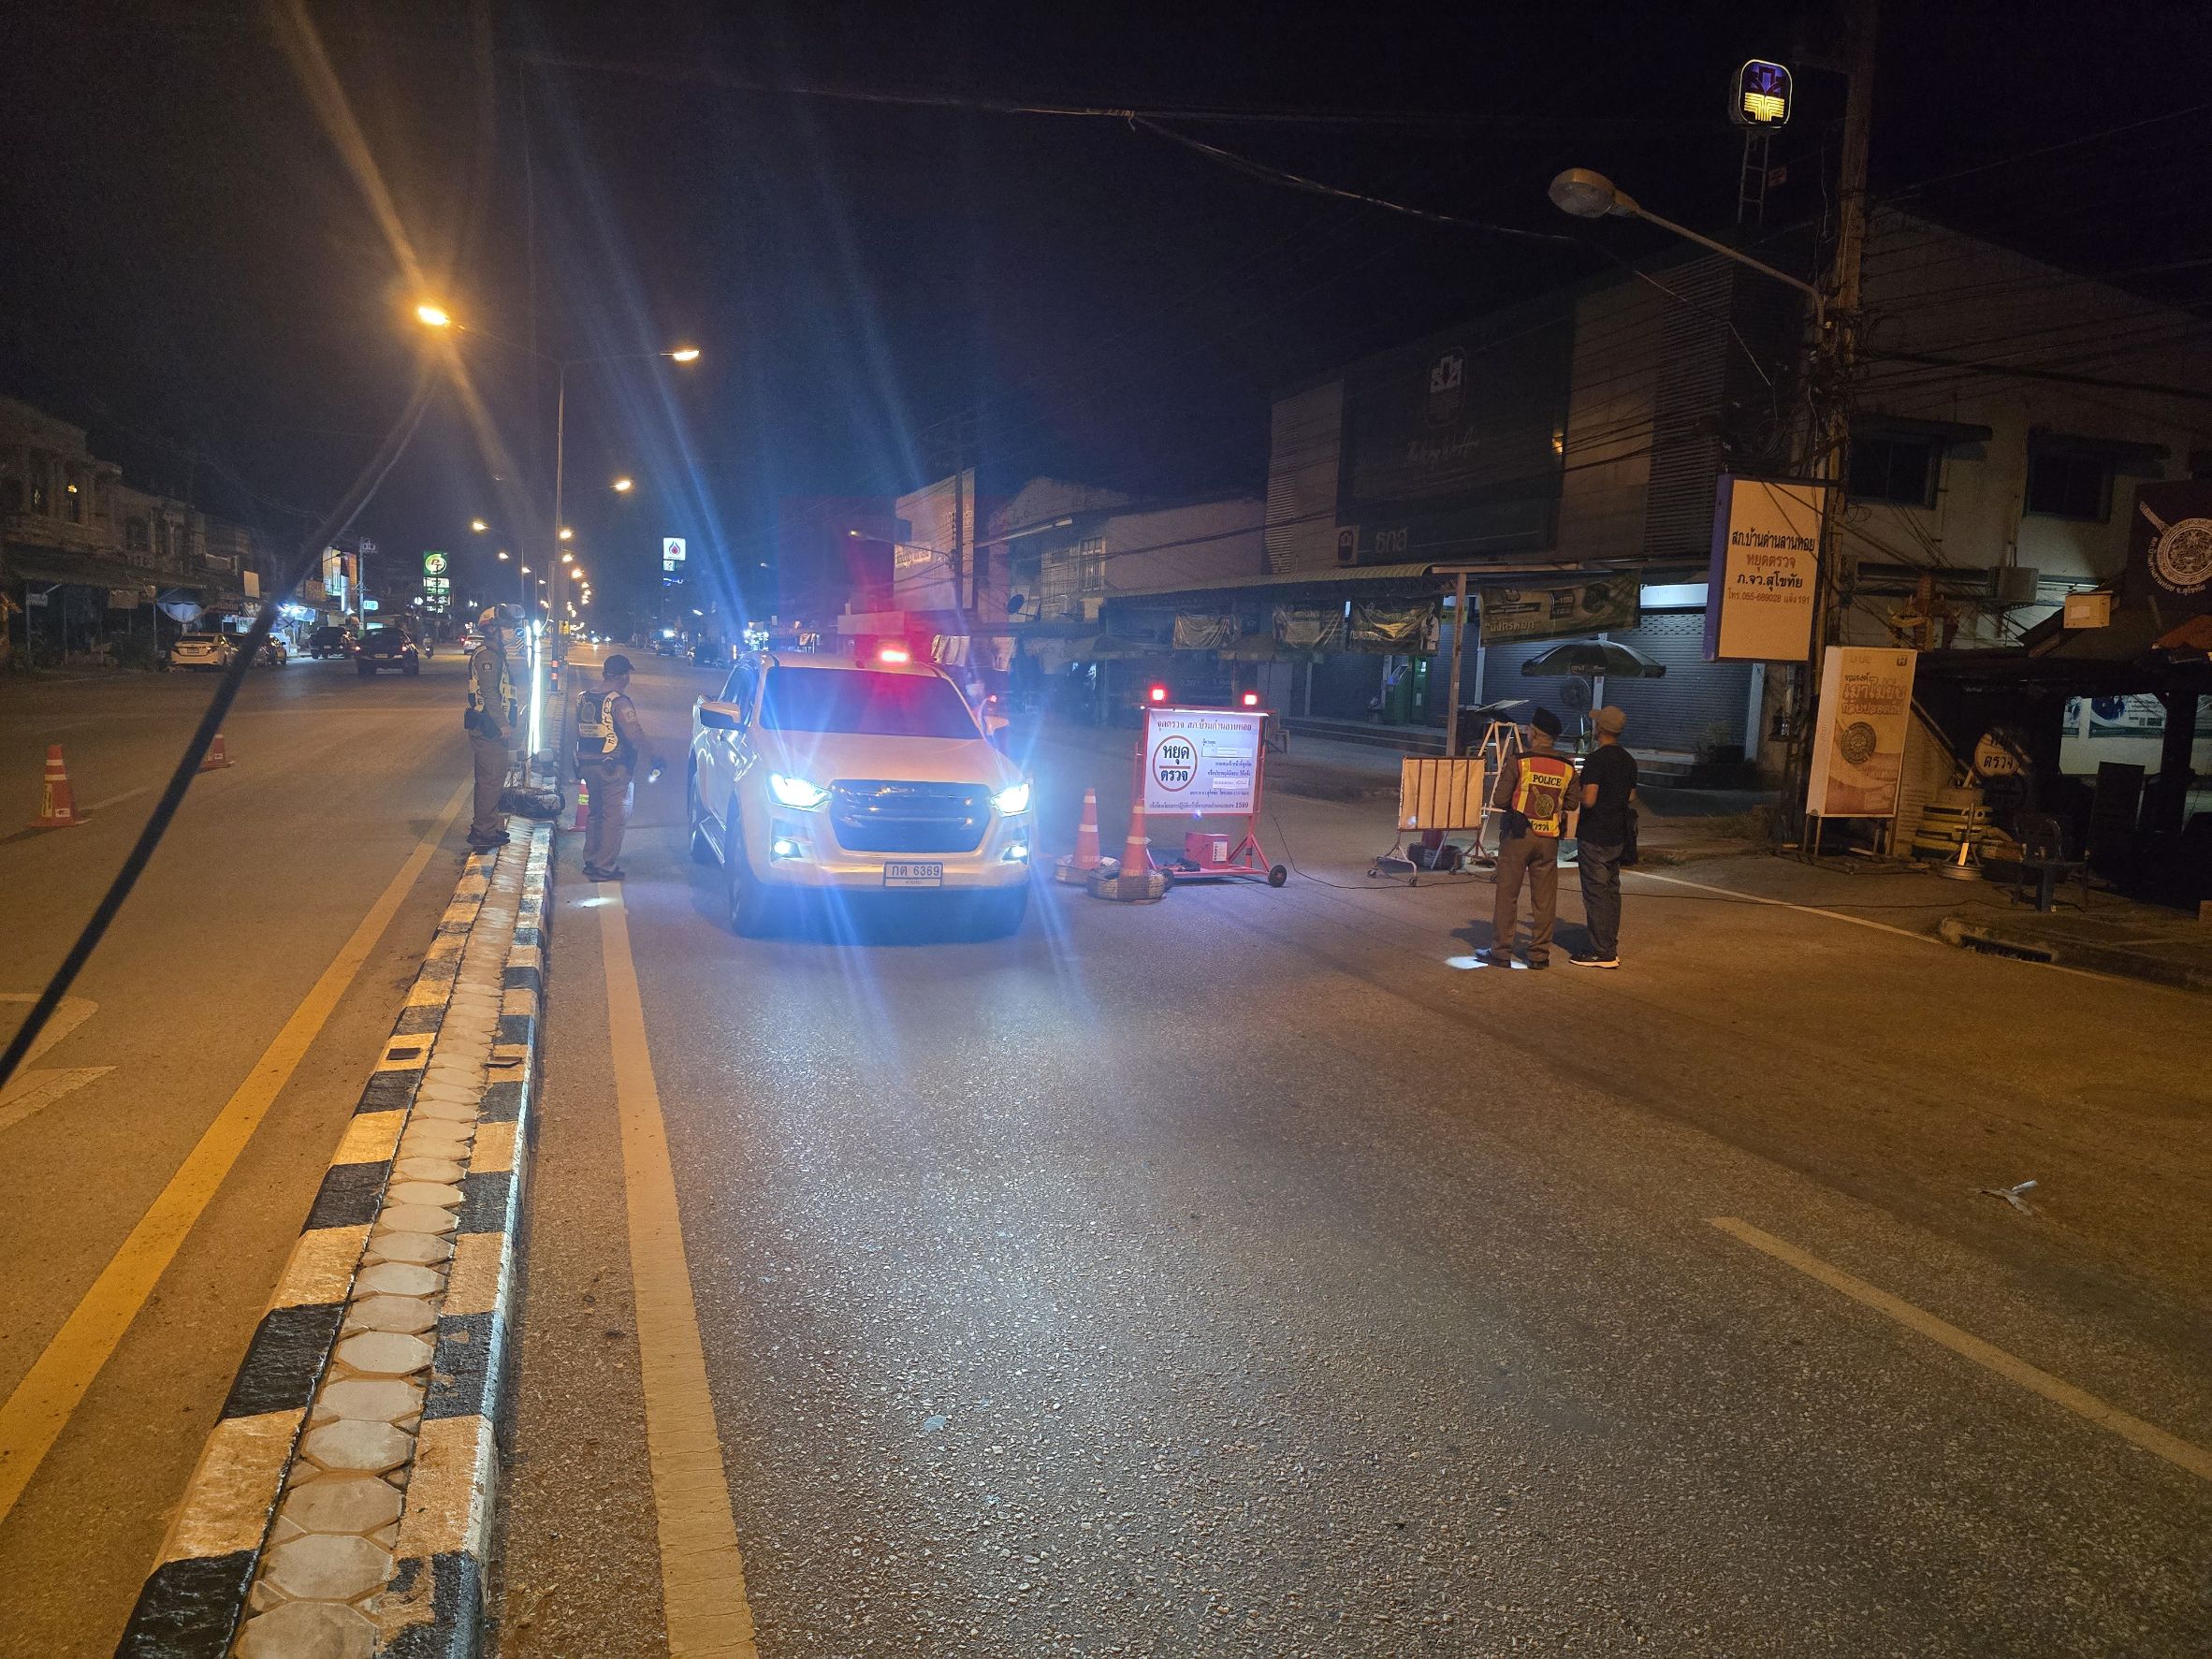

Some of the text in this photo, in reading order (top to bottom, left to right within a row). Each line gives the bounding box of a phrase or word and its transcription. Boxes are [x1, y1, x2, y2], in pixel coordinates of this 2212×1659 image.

[1731, 527, 1815, 551] สภ.บ้านด่านลานหอย
[1746, 553, 1797, 572] หยุดตรวจ
[1737, 573, 1803, 592] ภ.จว.สุโขทัย
[1162, 745, 1190, 765] หยุด
[1983, 755, 2014, 769] ตรวจ
[1160, 769, 1188, 782] ตรวจ
[1532, 773, 1562, 787] POLICE
[913, 866, 939, 876] 6369
